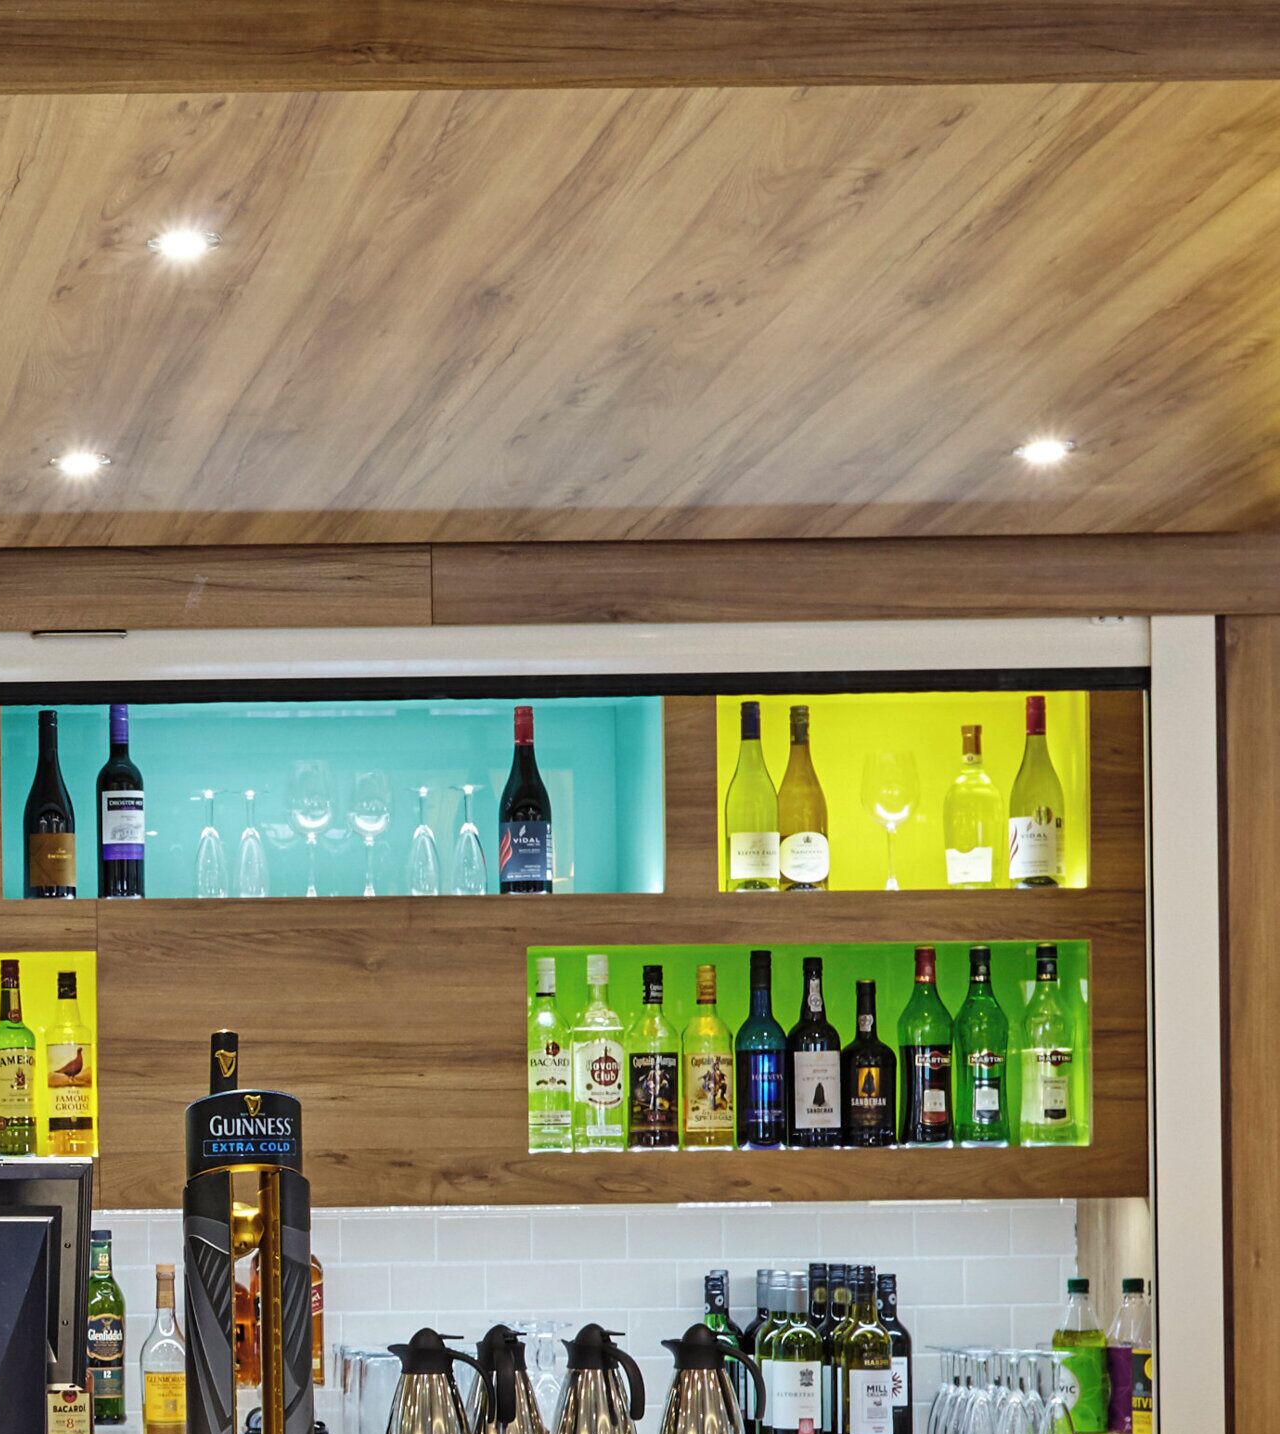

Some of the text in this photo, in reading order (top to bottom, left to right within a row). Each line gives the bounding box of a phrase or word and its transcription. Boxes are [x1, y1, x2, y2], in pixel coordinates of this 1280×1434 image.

[530, 1058, 570, 1067] BACARD
[632, 1057, 654, 1067] Captain
[594, 1071, 616, 1080] Club
[851, 1098, 886, 1106] SANDEMAN
[209, 1115, 292, 1136] GUINNESS
[212, 1142, 290, 1153] EXTRA COLD
[103, 1370, 112, 1378] 12
[867, 1385, 888, 1393] MILL
